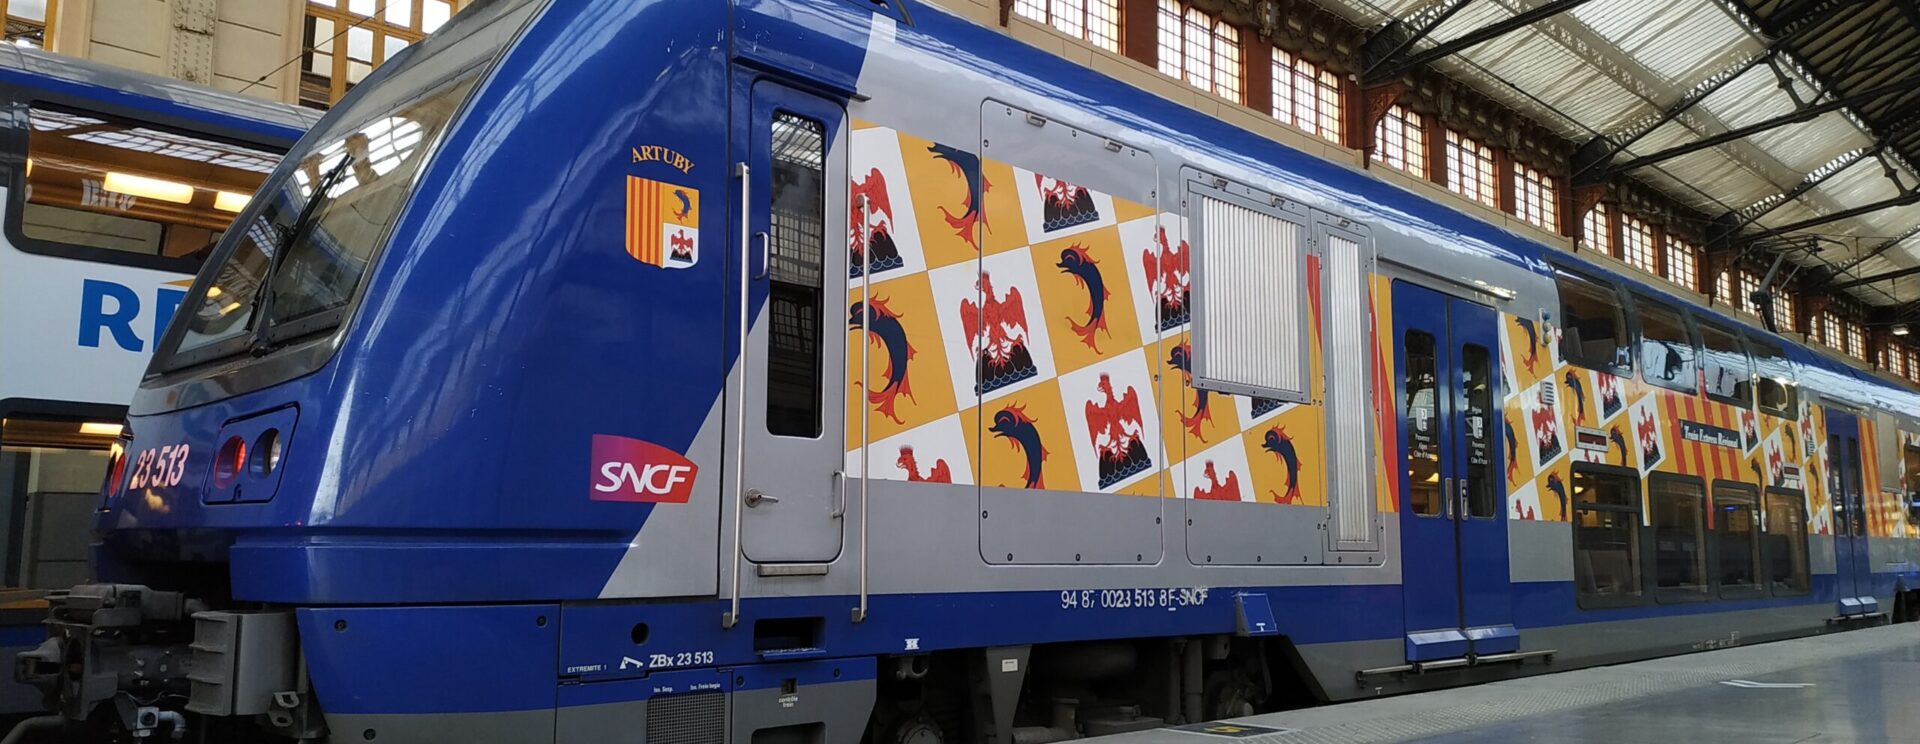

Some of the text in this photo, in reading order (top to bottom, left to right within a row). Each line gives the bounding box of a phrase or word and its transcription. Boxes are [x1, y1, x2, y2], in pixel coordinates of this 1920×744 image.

[632, 145, 695, 174] ARTUBY
[129, 444, 190, 490] 23 513
[595, 461, 691, 495] SNCF
[1061, 590, 1077, 609] 94
[1101, 589, 1131, 608] 0023
[1134, 588, 1155, 608] 513
[567, 664, 602, 673] EXTREMITE
[649, 651, 714, 669] ZBx 23 513
